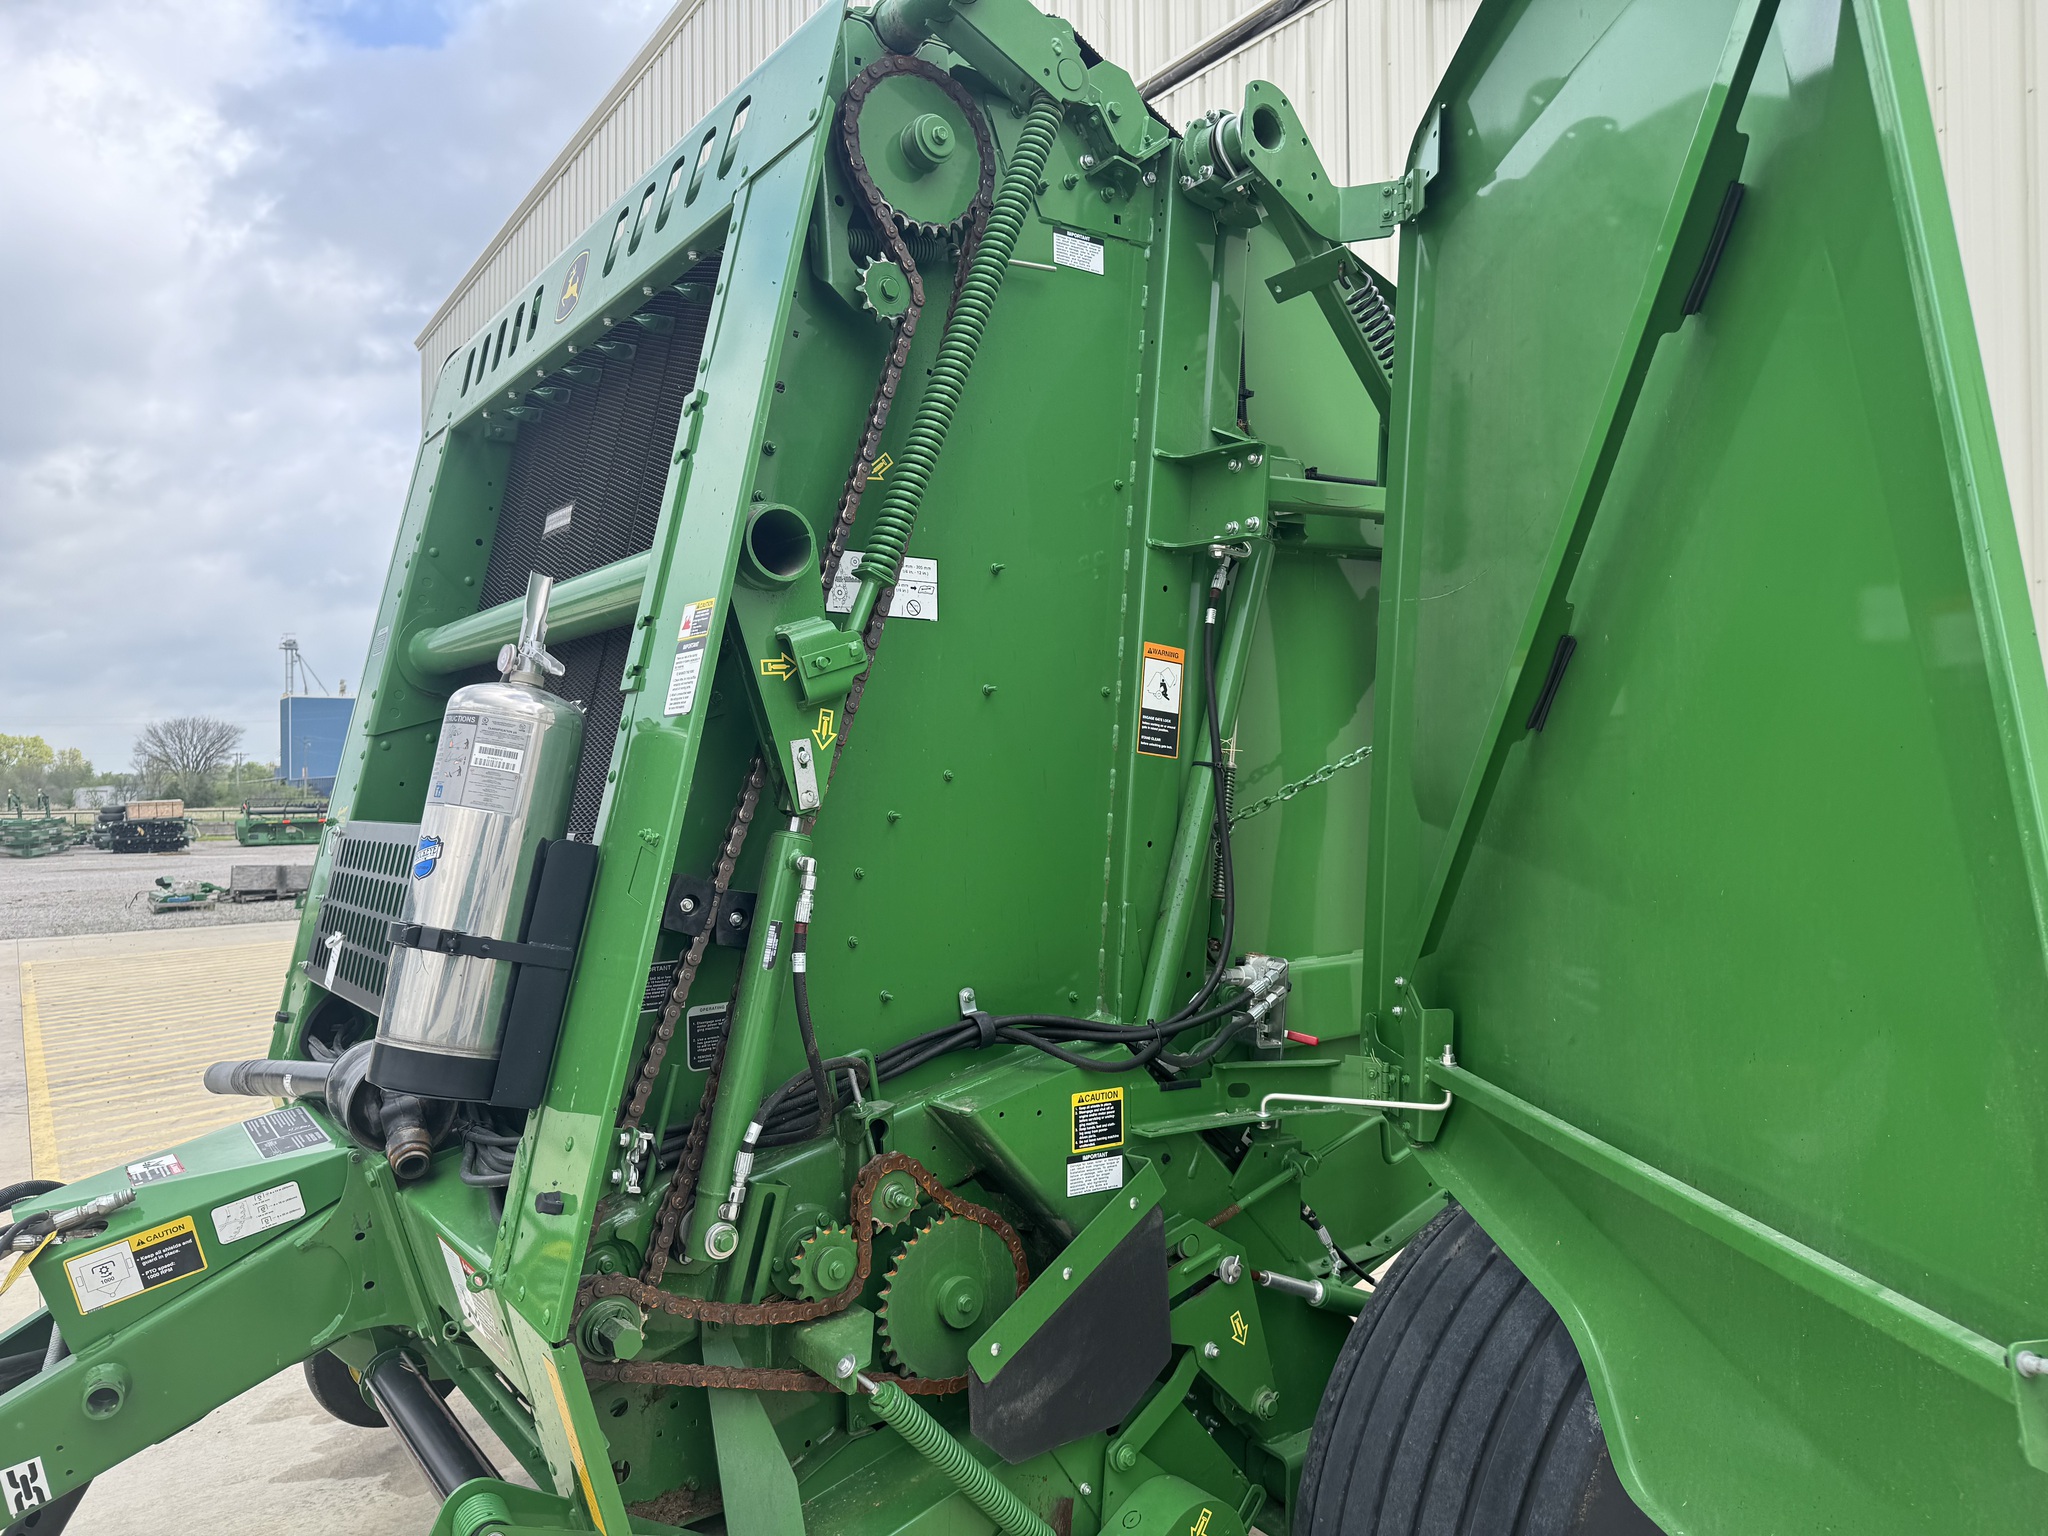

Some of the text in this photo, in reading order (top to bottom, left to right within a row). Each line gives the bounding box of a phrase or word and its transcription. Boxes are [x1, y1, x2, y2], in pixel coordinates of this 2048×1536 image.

[1066, 230, 1091, 242] IMPORTANT
[1152, 650, 1179, 659] WARNING
[1085, 1090, 1118, 1102] CAUTION
[1082, 1152, 1108, 1160] IMPORTANT
[145, 1224, 185, 1243] CAUTION
[140, 1252, 155, 1261] Keep
[162, 1244, 181, 1254] shields
[182, 1239, 192, 1247] and
[142, 1258, 158, 1266] guard
[145, 1267, 158, 1276] PTO
[147, 1267, 174, 1280] 1000 RPM
[100, 1276, 115, 1285] 1000
